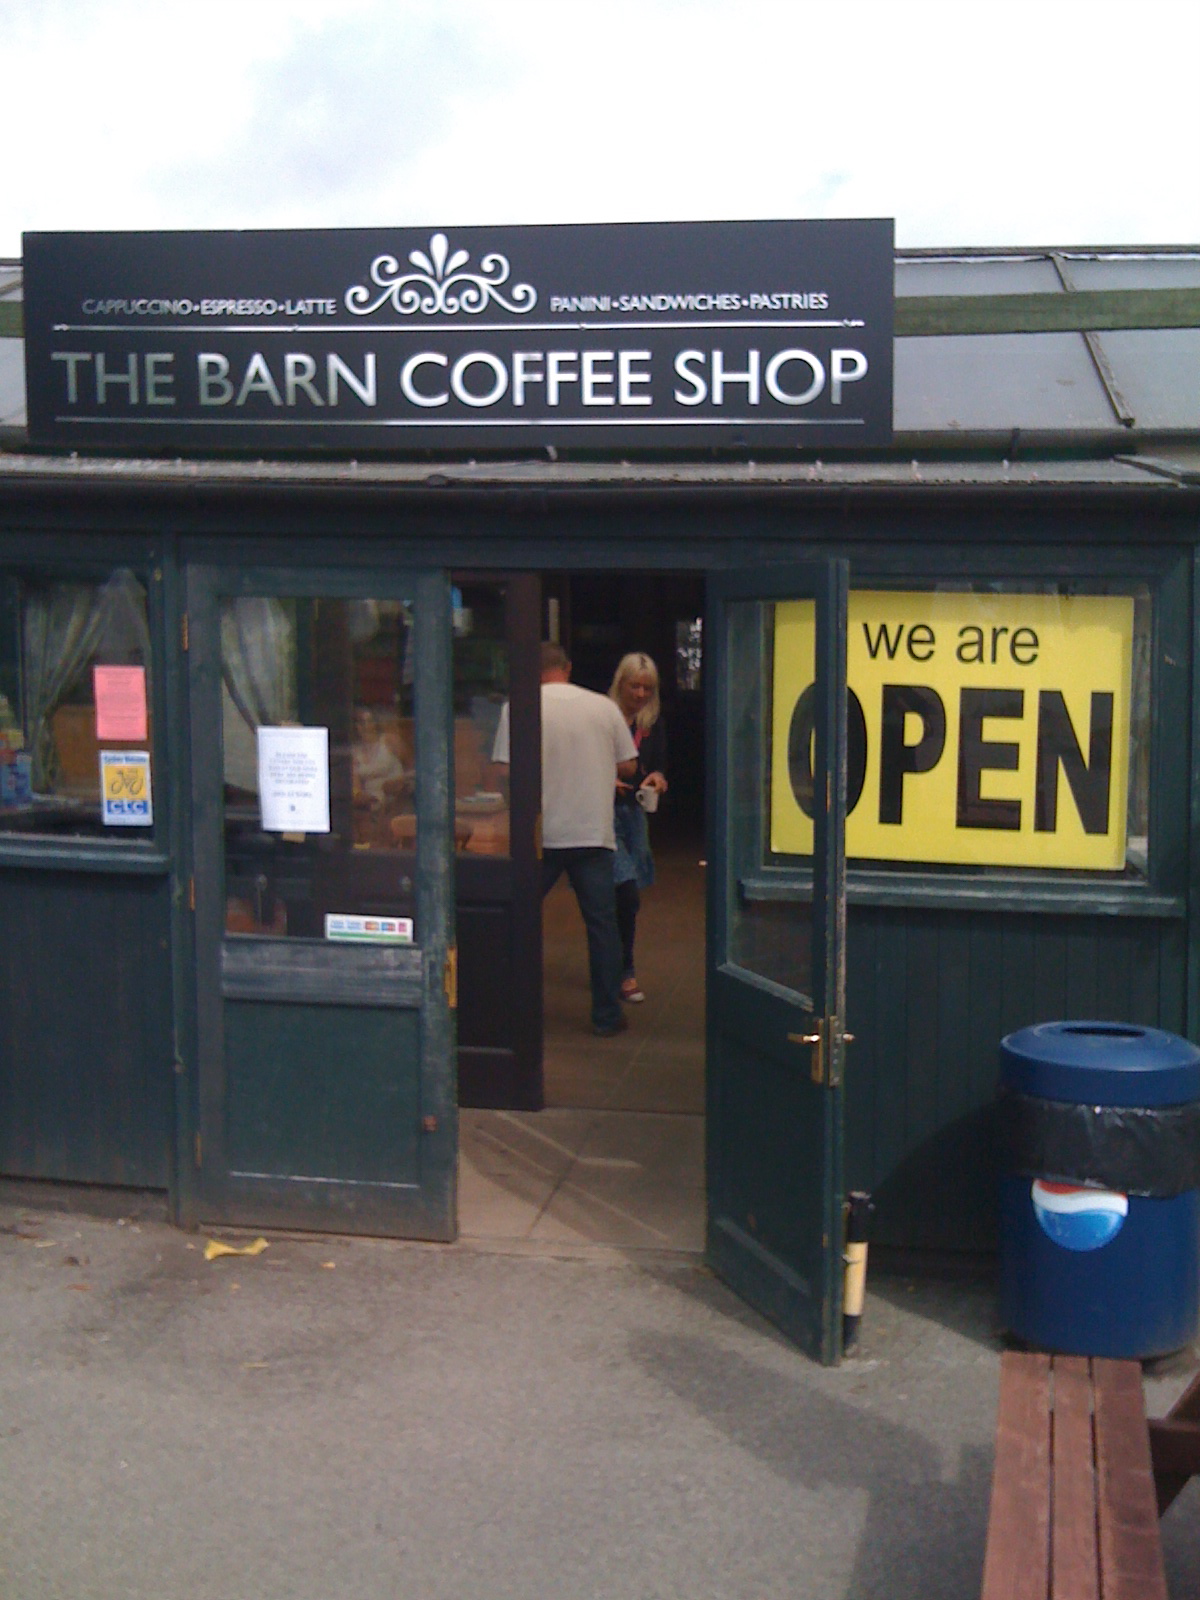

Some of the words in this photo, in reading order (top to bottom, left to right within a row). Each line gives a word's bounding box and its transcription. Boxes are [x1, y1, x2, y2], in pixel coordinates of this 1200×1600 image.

[51, 352, 176, 405] THE
[197, 352, 377, 407] BARN
[400, 350, 653, 408] COFFEE
[673, 348, 868, 406] SHOP
[862, 622, 936, 662] we
[955, 624, 1040, 666] are
[787, 680, 1115, 835] OPEN
